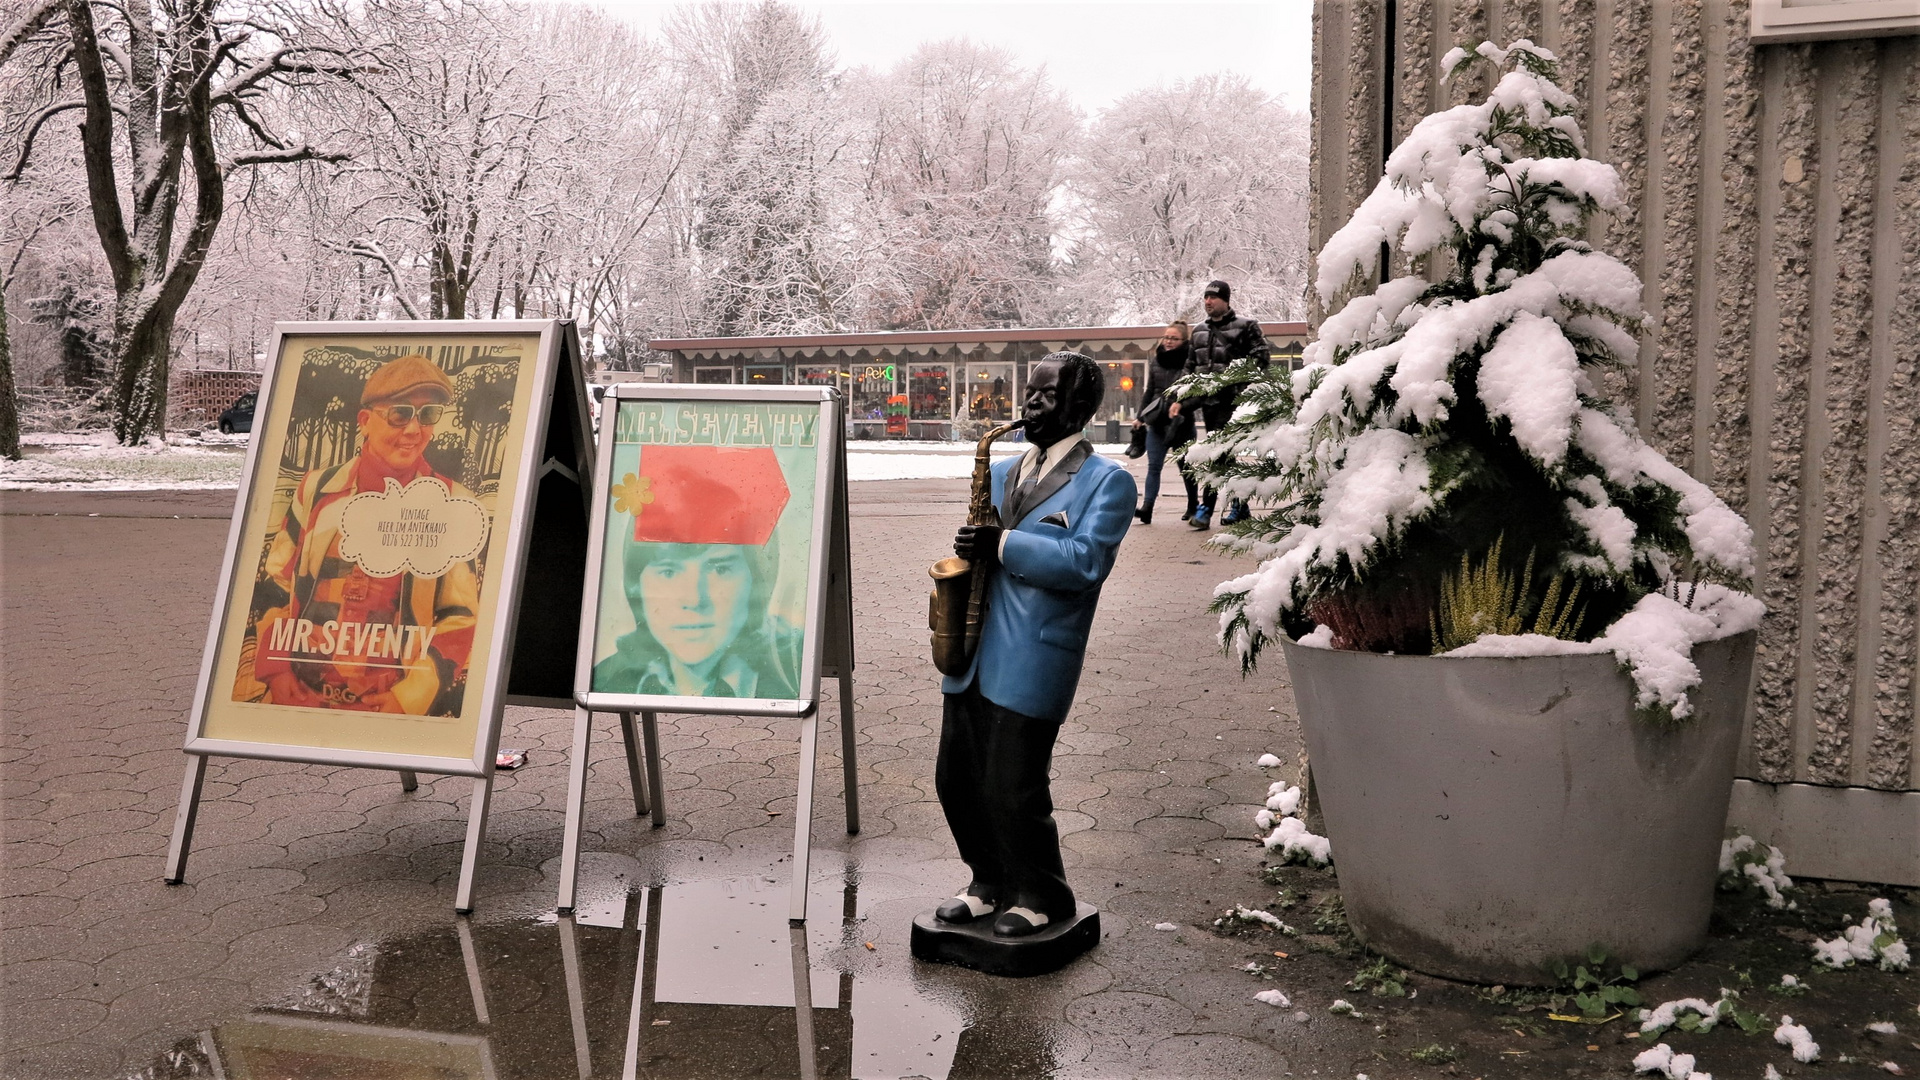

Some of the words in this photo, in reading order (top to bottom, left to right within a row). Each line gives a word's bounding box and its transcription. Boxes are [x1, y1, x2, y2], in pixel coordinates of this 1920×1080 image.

[674, 402, 819, 447] SEVENTY
[400, 507, 430, 520] VINTAGE
[377, 521, 393, 532] HIER
[395, 521, 406, 533] IM
[407, 521, 448, 534] ANTIKHAUS
[381, 533, 398, 547] 0176
[400, 534, 413, 547] 522
[415, 534, 424, 548] 39
[425, 535, 438, 548] 153
[322, 684, 356, 703] D&G
